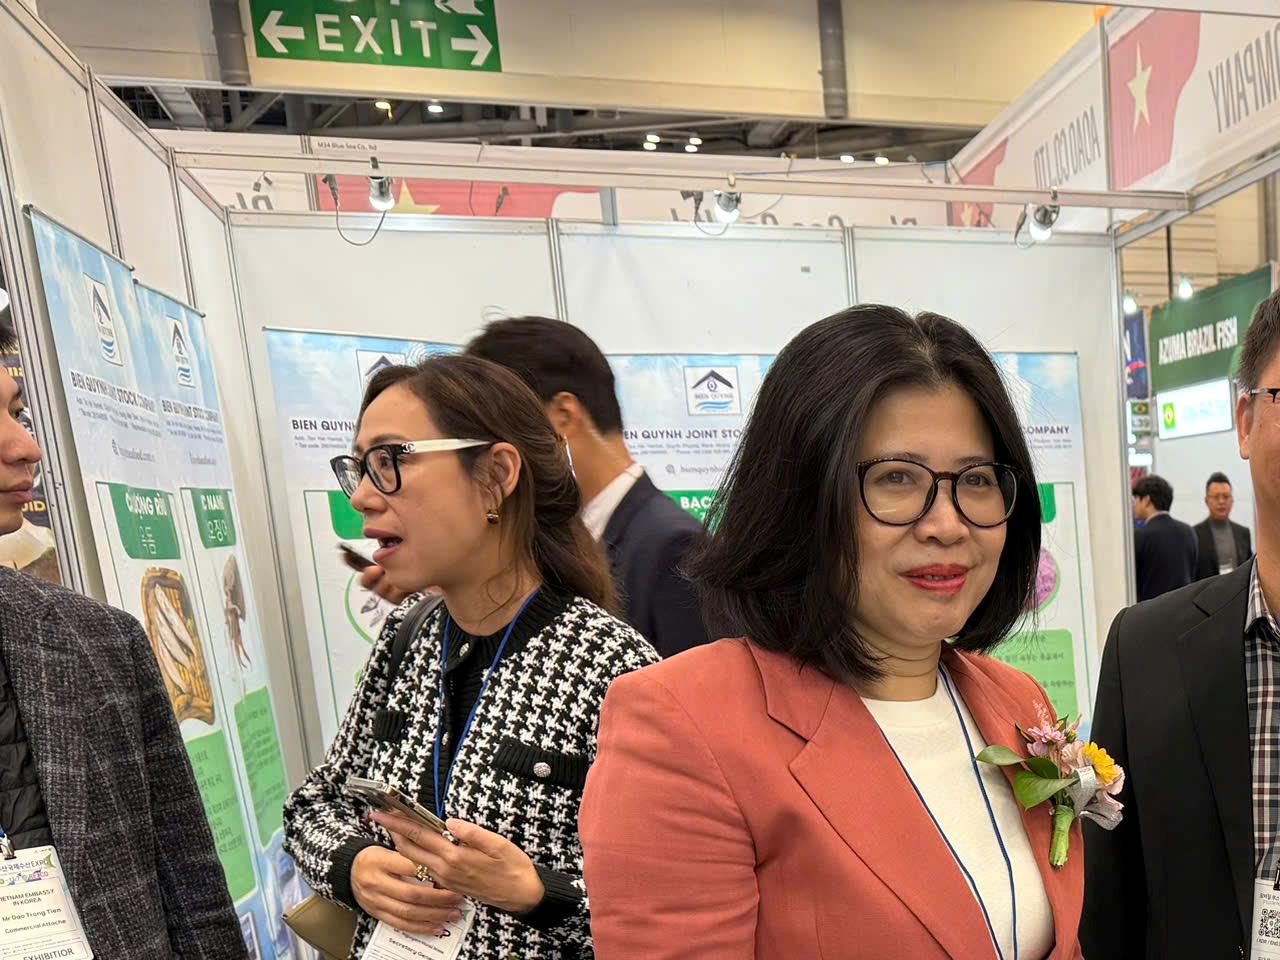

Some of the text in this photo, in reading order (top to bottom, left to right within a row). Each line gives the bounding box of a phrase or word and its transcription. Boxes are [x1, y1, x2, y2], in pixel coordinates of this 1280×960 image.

[315, 14, 437, 58] EXIT
[1158, 333, 1186, 365] AZUMA
[1186, 324, 1216, 357] BRAZIL
[1216, 316, 1238, 350] FISH
[292, 419, 317, 430] BIEN
[624, 430, 638, 440] EN
[642, 430, 682, 440] QUYNH
[685, 430, 717, 439] JOINT
[25, 888, 54, 898] EMBASSY
[20, 898, 42, 906] KOREA
[5, 924, 41, 934] Commercial
